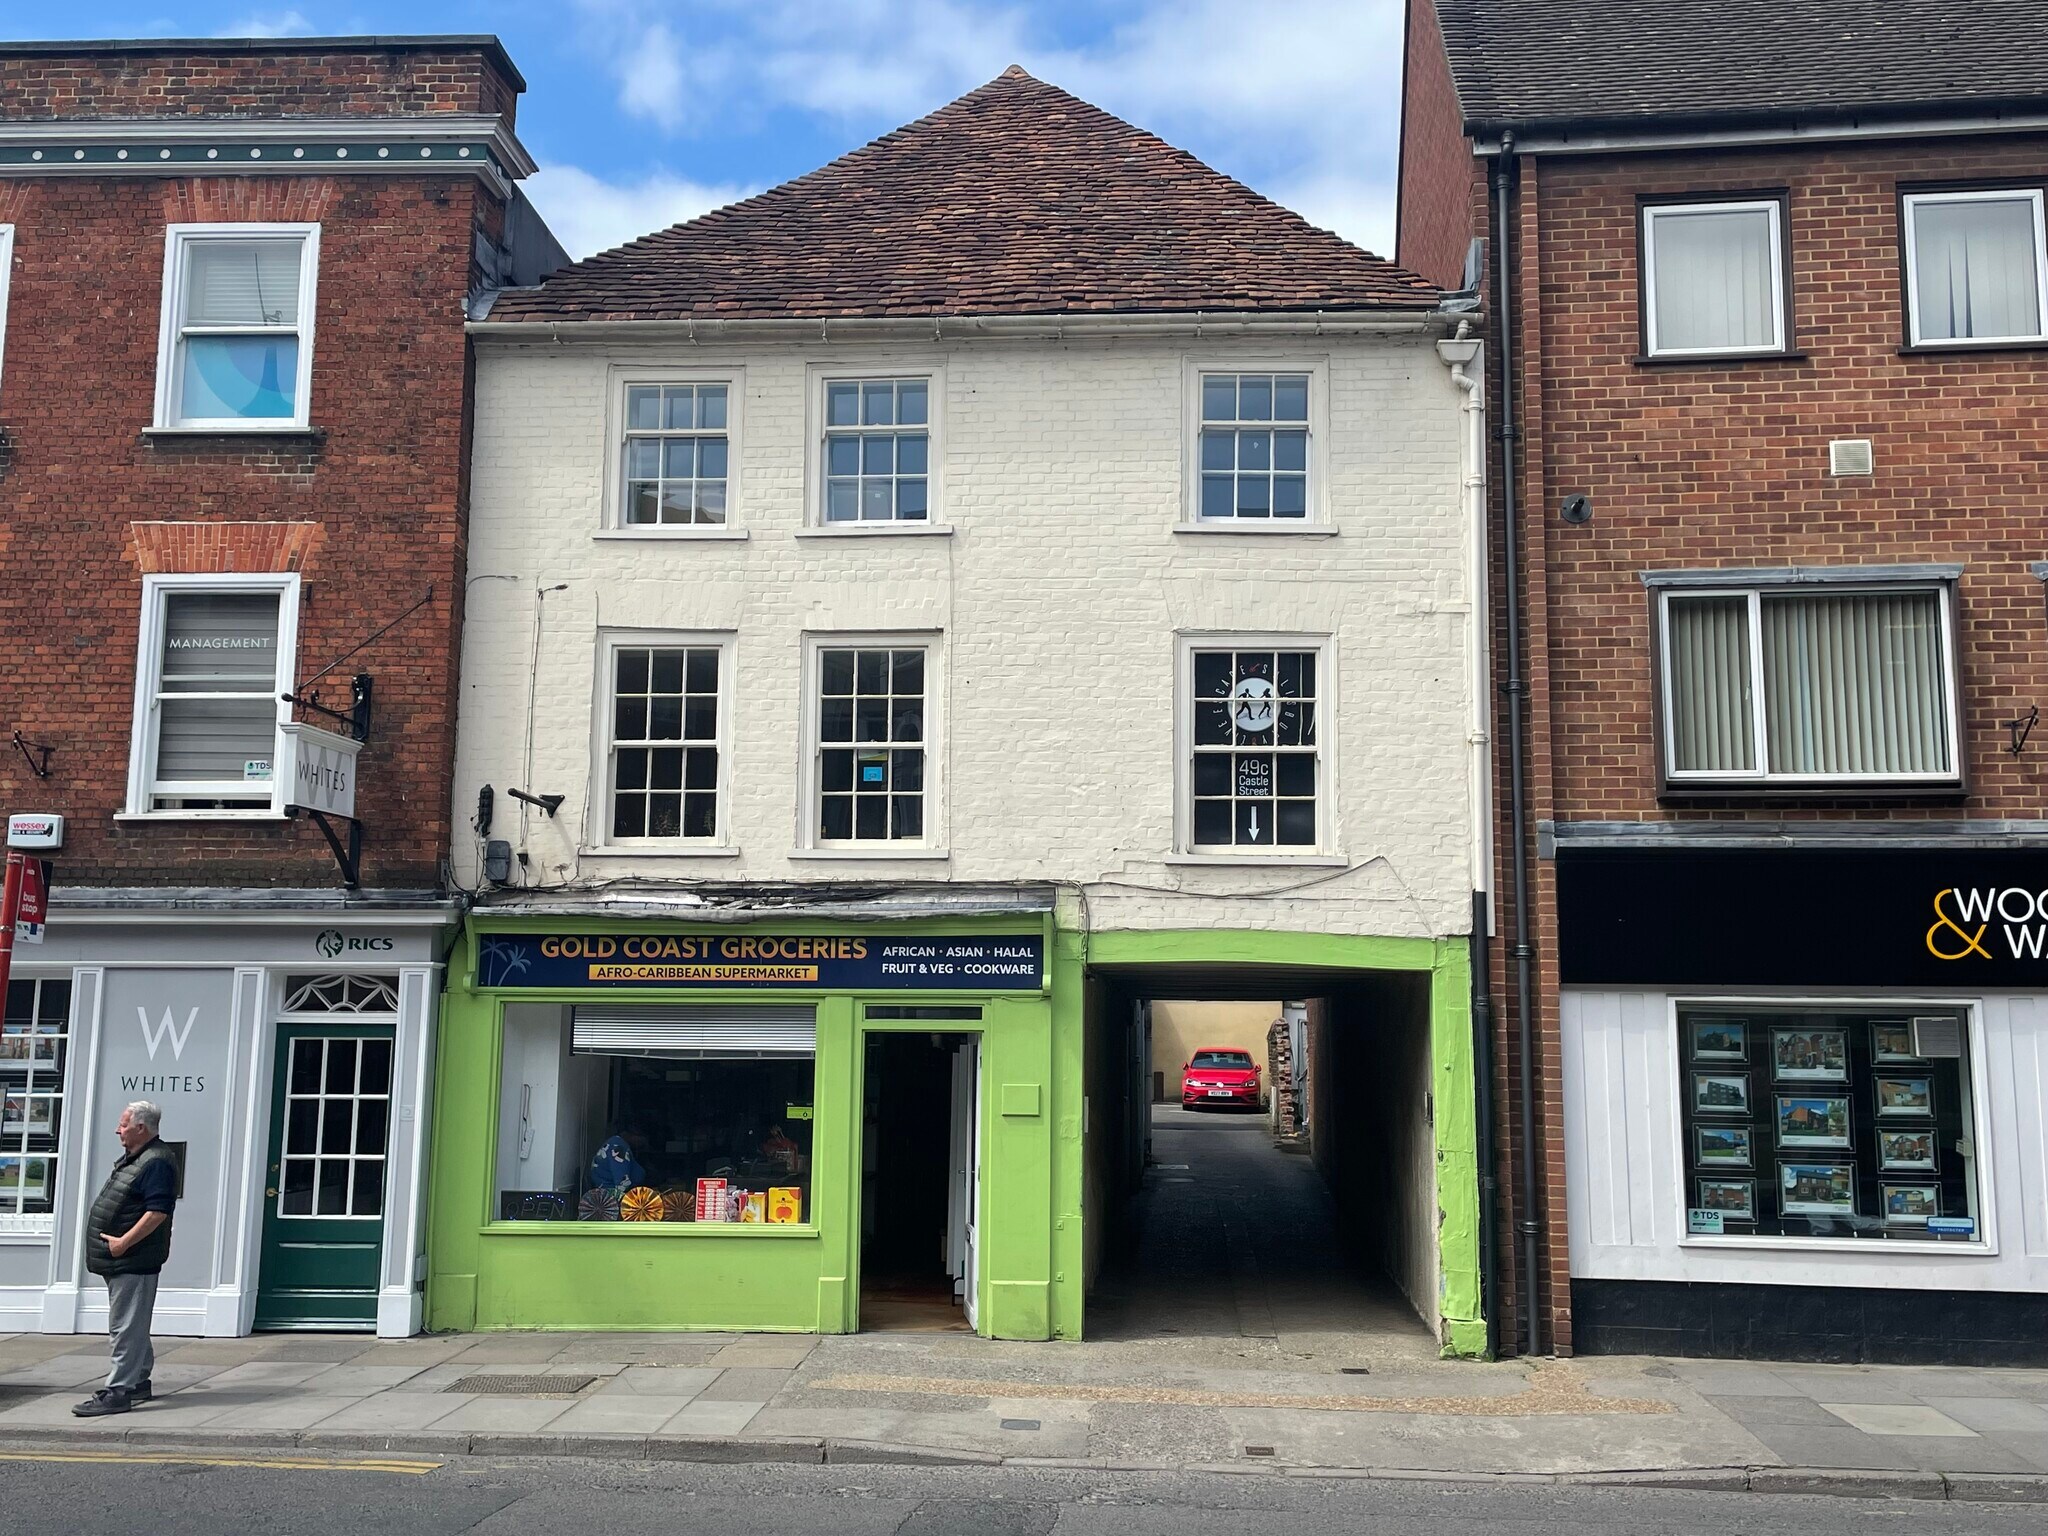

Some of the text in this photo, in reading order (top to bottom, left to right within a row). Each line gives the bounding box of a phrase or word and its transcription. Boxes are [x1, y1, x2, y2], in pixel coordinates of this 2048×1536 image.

[169, 638, 270, 649] MANAGEMENT
[1213, 665, 1246, 714] ECAPE
[1239, 759, 1269, 775] 49c
[298, 760, 345, 792] WHITES
[1239, 775, 1269, 786] Castle
[1239, 786, 1269, 796] Street
[13, 822, 46, 830] wessex
[23, 891, 36, 903] bus
[21, 903, 38, 916] stop
[1926, 889, 2048, 960] & W
[348, 937, 394, 951] RICS
[541, 936, 868, 959] GOLD COAST GROCERIES
[882, 946, 1034, 957] AFRICAN ASIAN HALAL
[596, 967, 810, 979] AFRO-CARIBBEAN SUPERMARKET
[882, 963, 1035, 975] FRUIT & VEG COOKWARE
[137, 1004, 200, 1062] W
[121, 1076, 205, 1092] WHITES
[505, 1199, 566, 1218] OPEN
[1700, 1211, 1719, 1220] TDS
